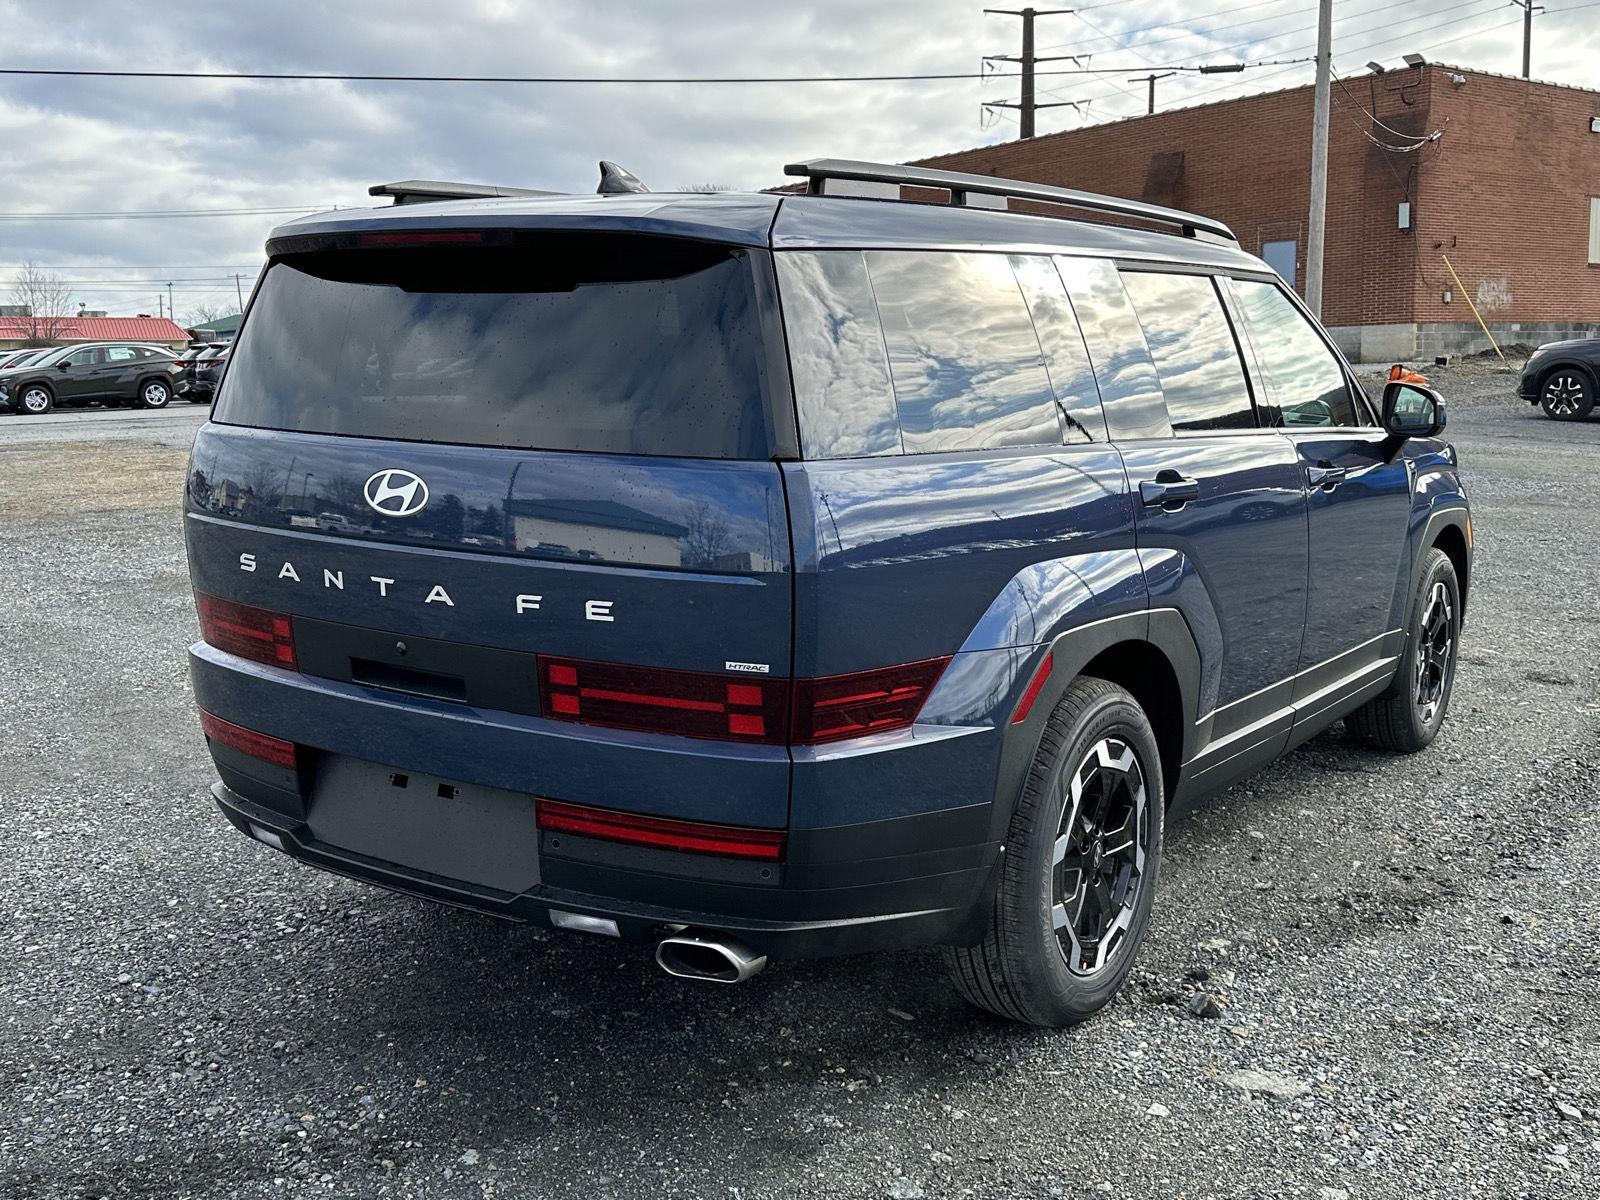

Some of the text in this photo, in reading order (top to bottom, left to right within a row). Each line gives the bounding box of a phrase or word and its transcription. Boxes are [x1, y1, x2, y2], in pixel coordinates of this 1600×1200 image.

[239, 552, 616, 623] SANTA FE
[727, 662, 768, 672] HTRAC
